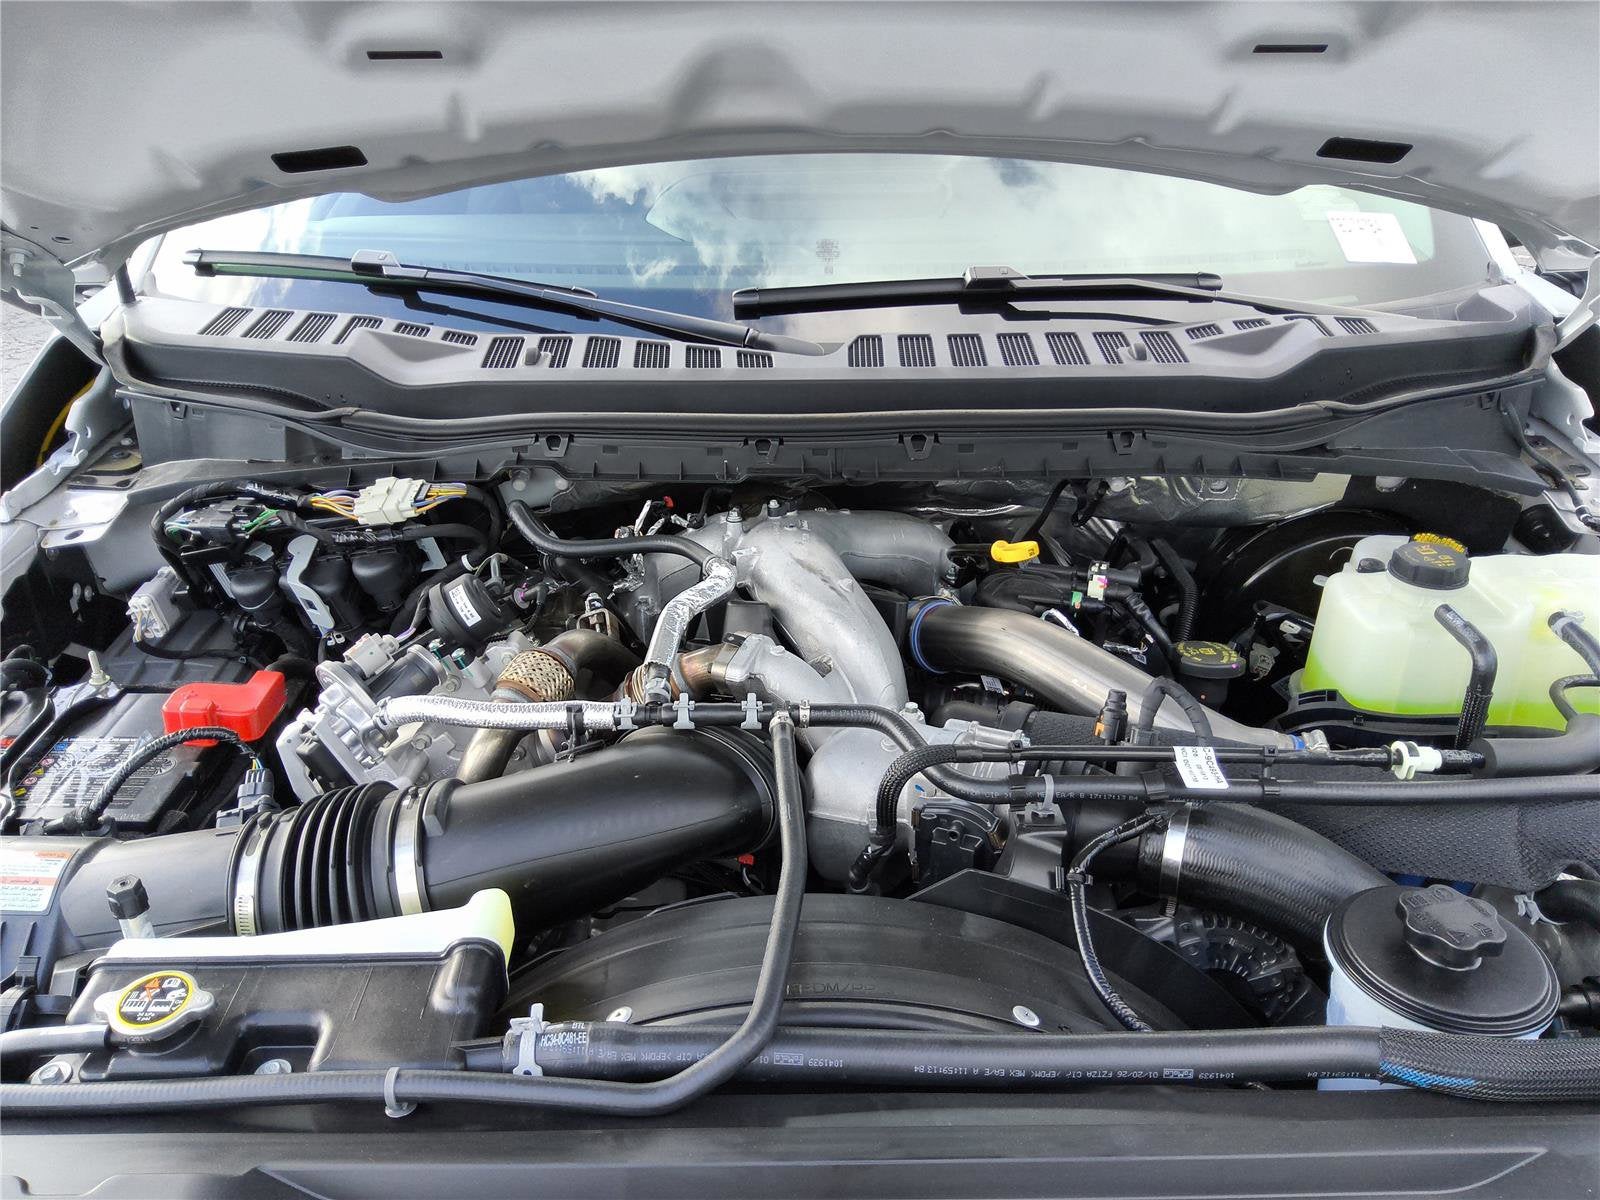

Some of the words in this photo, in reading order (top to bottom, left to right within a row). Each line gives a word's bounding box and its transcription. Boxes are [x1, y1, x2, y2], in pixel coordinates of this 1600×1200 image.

[808, 1058, 844, 1068] 1041939
[927, 1065, 968, 1075] 11:59:13
[1009, 1069, 1026, 1077] MEX
[1116, 1070, 1159, 1079] 01/20/26
[1198, 1071, 1236, 1080] 1041939
